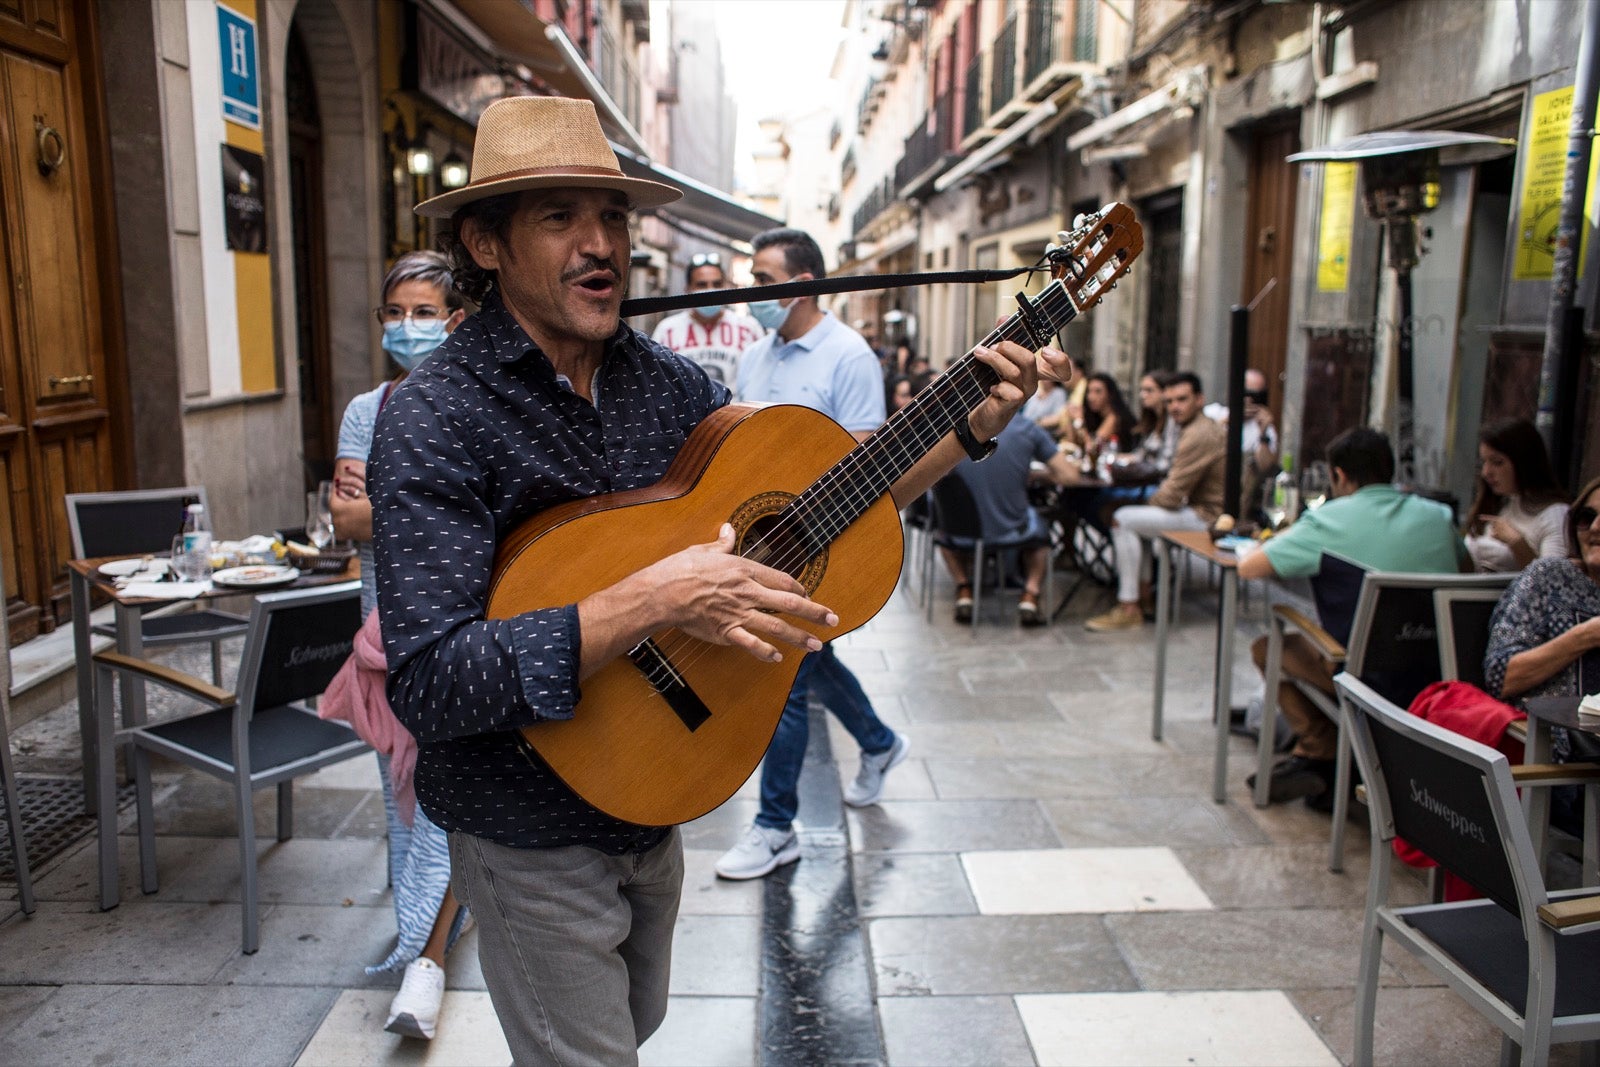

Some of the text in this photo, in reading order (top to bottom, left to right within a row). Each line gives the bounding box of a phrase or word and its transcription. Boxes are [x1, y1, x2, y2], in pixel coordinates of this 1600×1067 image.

[227, 22, 249, 79] H
[662, 320, 758, 352] LAYOF
[1409, 778, 1486, 844] Schweppes
